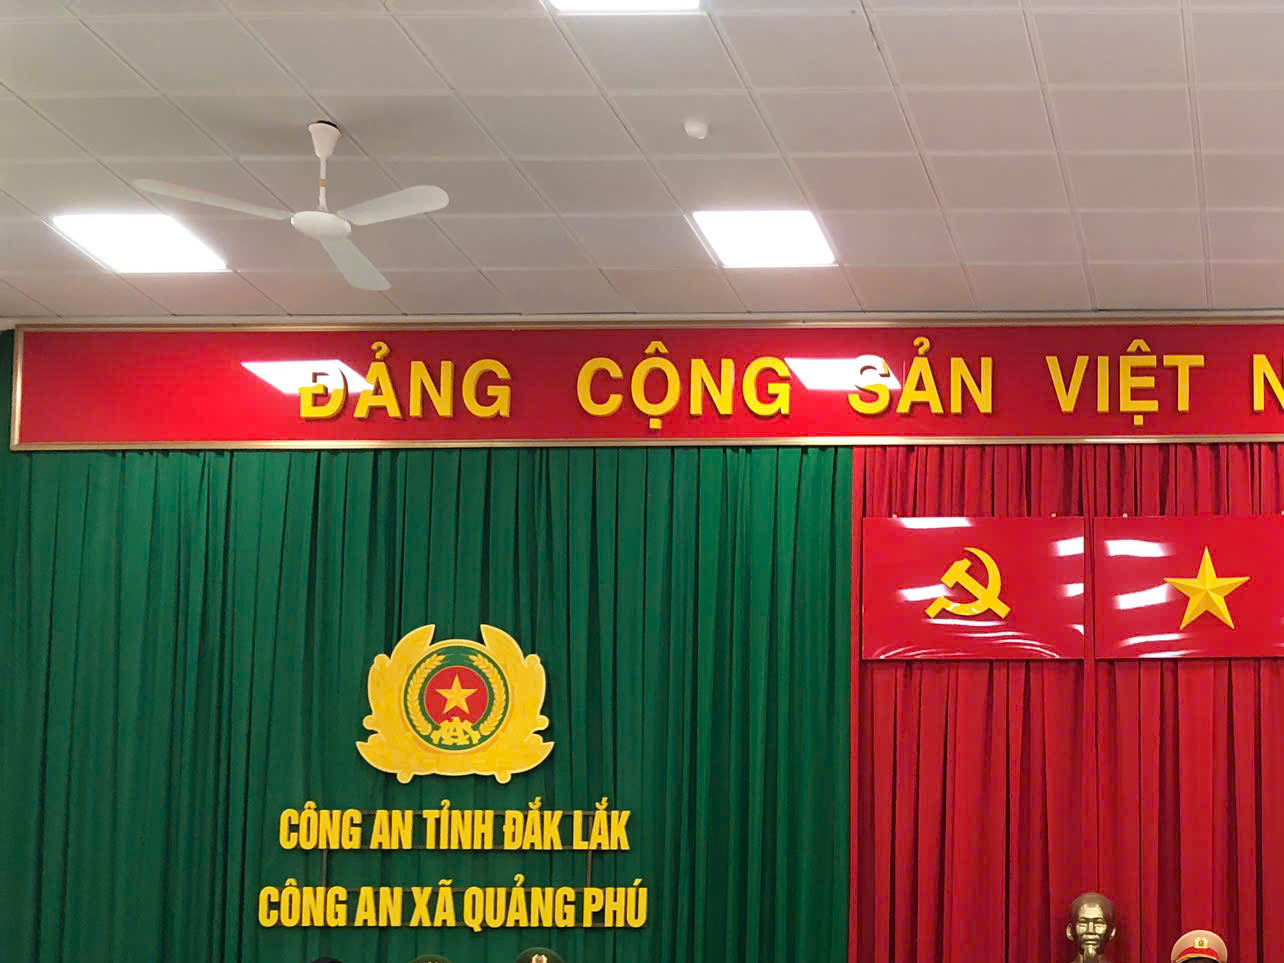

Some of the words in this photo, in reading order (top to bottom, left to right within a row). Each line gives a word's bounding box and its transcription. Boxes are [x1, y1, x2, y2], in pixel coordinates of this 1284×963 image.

[298, 342, 511, 418] ĐẢNG
[577, 341, 791, 429] CỘNG
[848, 337, 992, 414] SẢN
[1046, 339, 1204, 425] VIỆT
[280, 801, 362, 849] CÔNG
[370, 810, 413, 849] AN
[423, 800, 494, 849] TỈNH
[503, 797, 563, 850] ĐẮK
[573, 797, 630, 850] LẮK
[259, 878, 347, 927] CÔNG
[354, 887, 402, 926] AN
[410, 879, 456, 926] XÃ
[464, 874, 575, 932] QUẢNG
[583, 879, 647, 927] PHÚ
